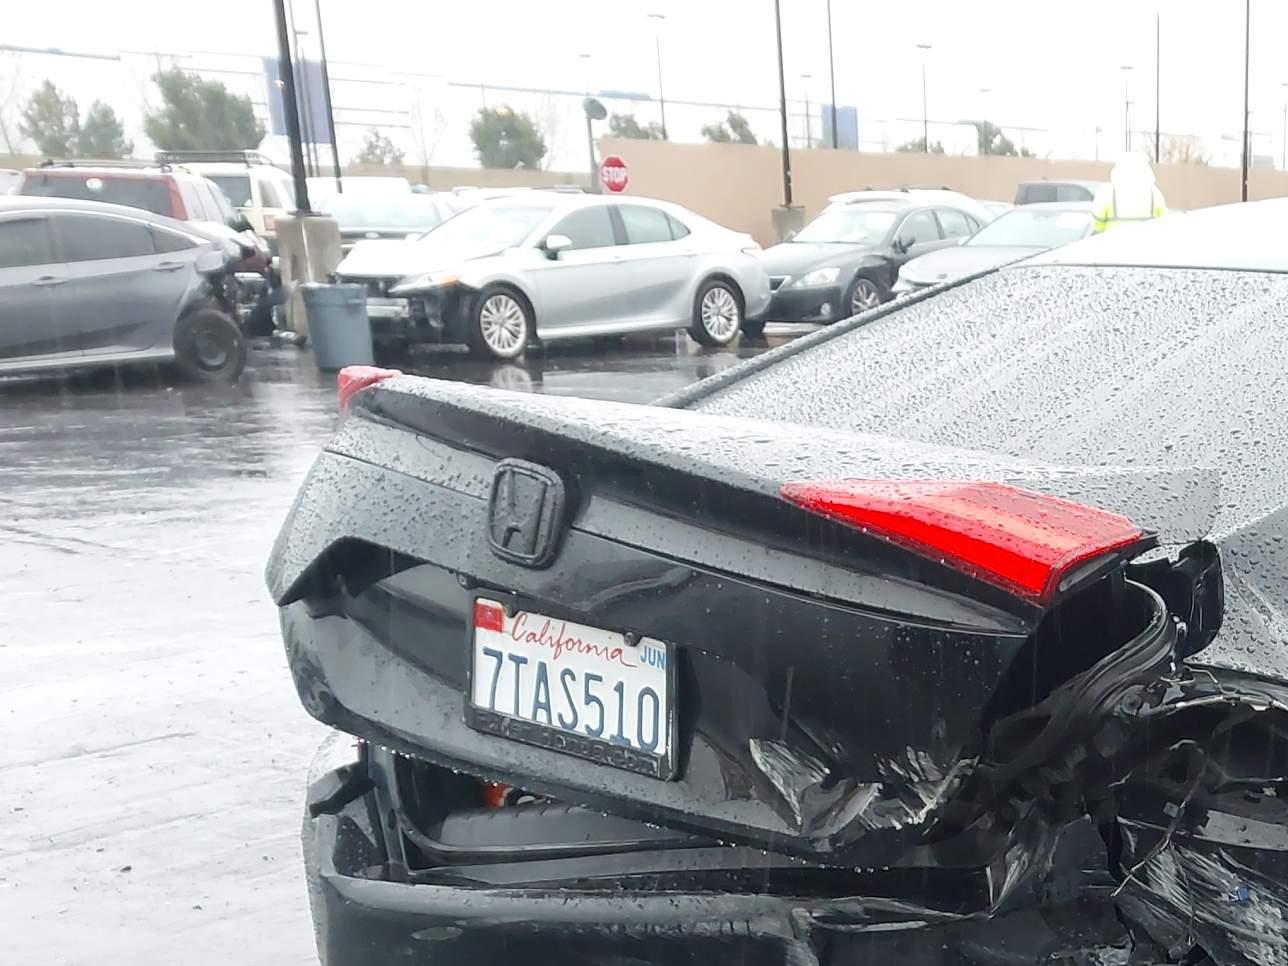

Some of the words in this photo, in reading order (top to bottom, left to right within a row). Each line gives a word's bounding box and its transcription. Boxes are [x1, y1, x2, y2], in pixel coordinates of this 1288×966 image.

[602, 166, 626, 183] STOP
[511, 612, 638, 668] California
[640, 645, 666, 670] JUN
[482, 646, 660, 753] 7TAS510
